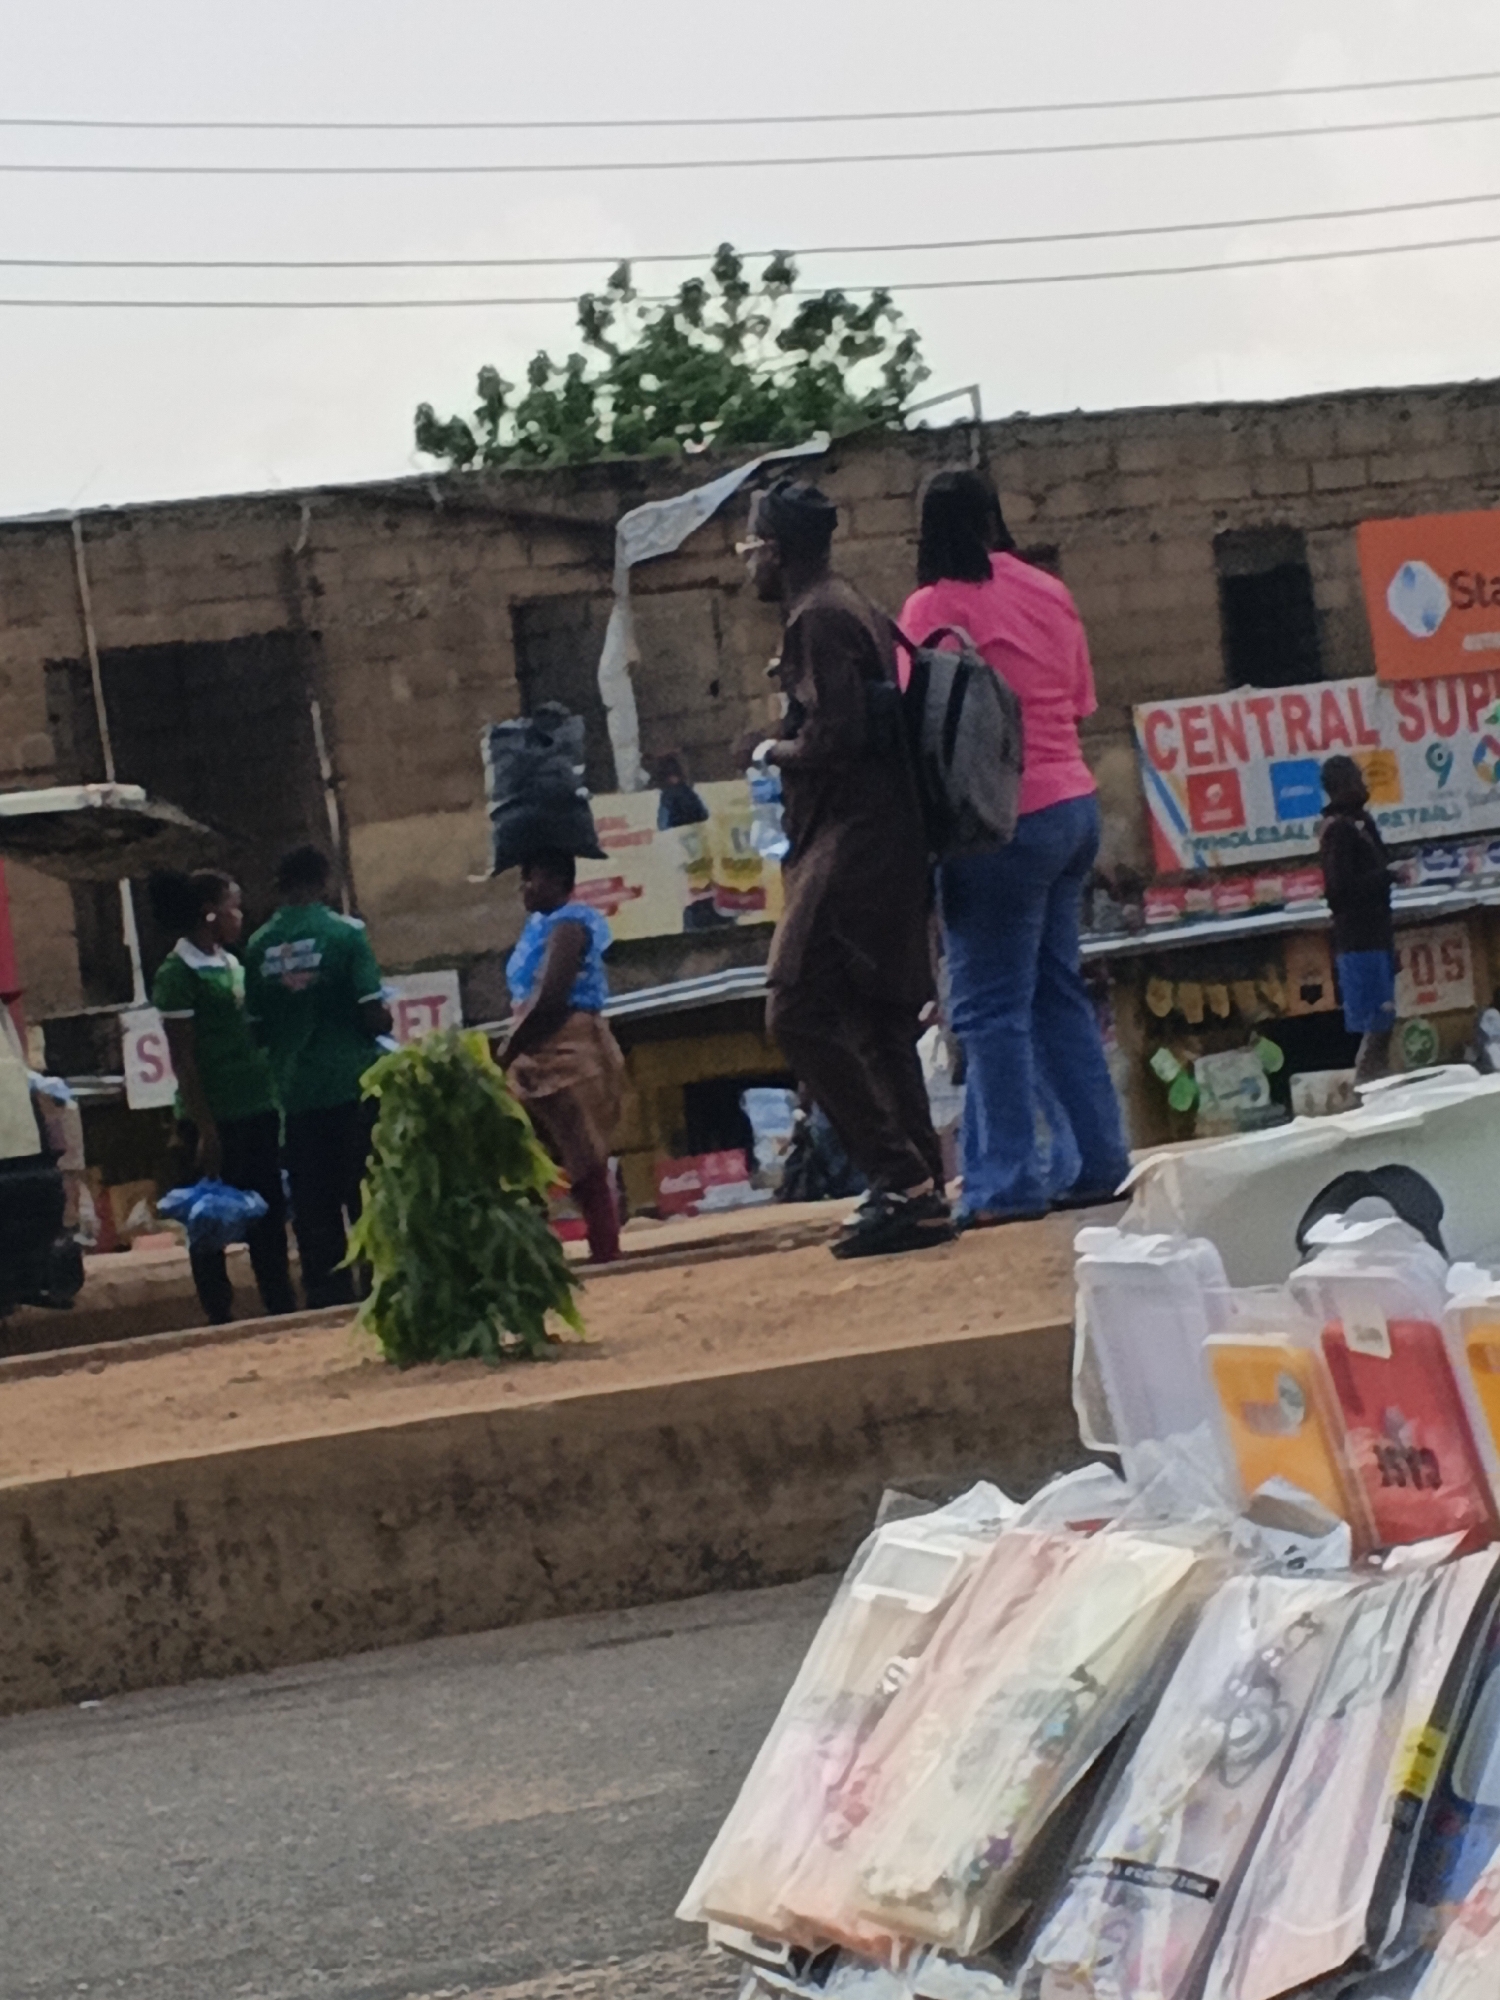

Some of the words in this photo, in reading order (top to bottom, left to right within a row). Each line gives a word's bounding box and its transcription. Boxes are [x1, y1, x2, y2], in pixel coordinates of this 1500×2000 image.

[1144, 688, 1381, 772] CENTRAL
[1393, 668, 1500, 743] SUP
[136, 1032, 164, 1084] S
